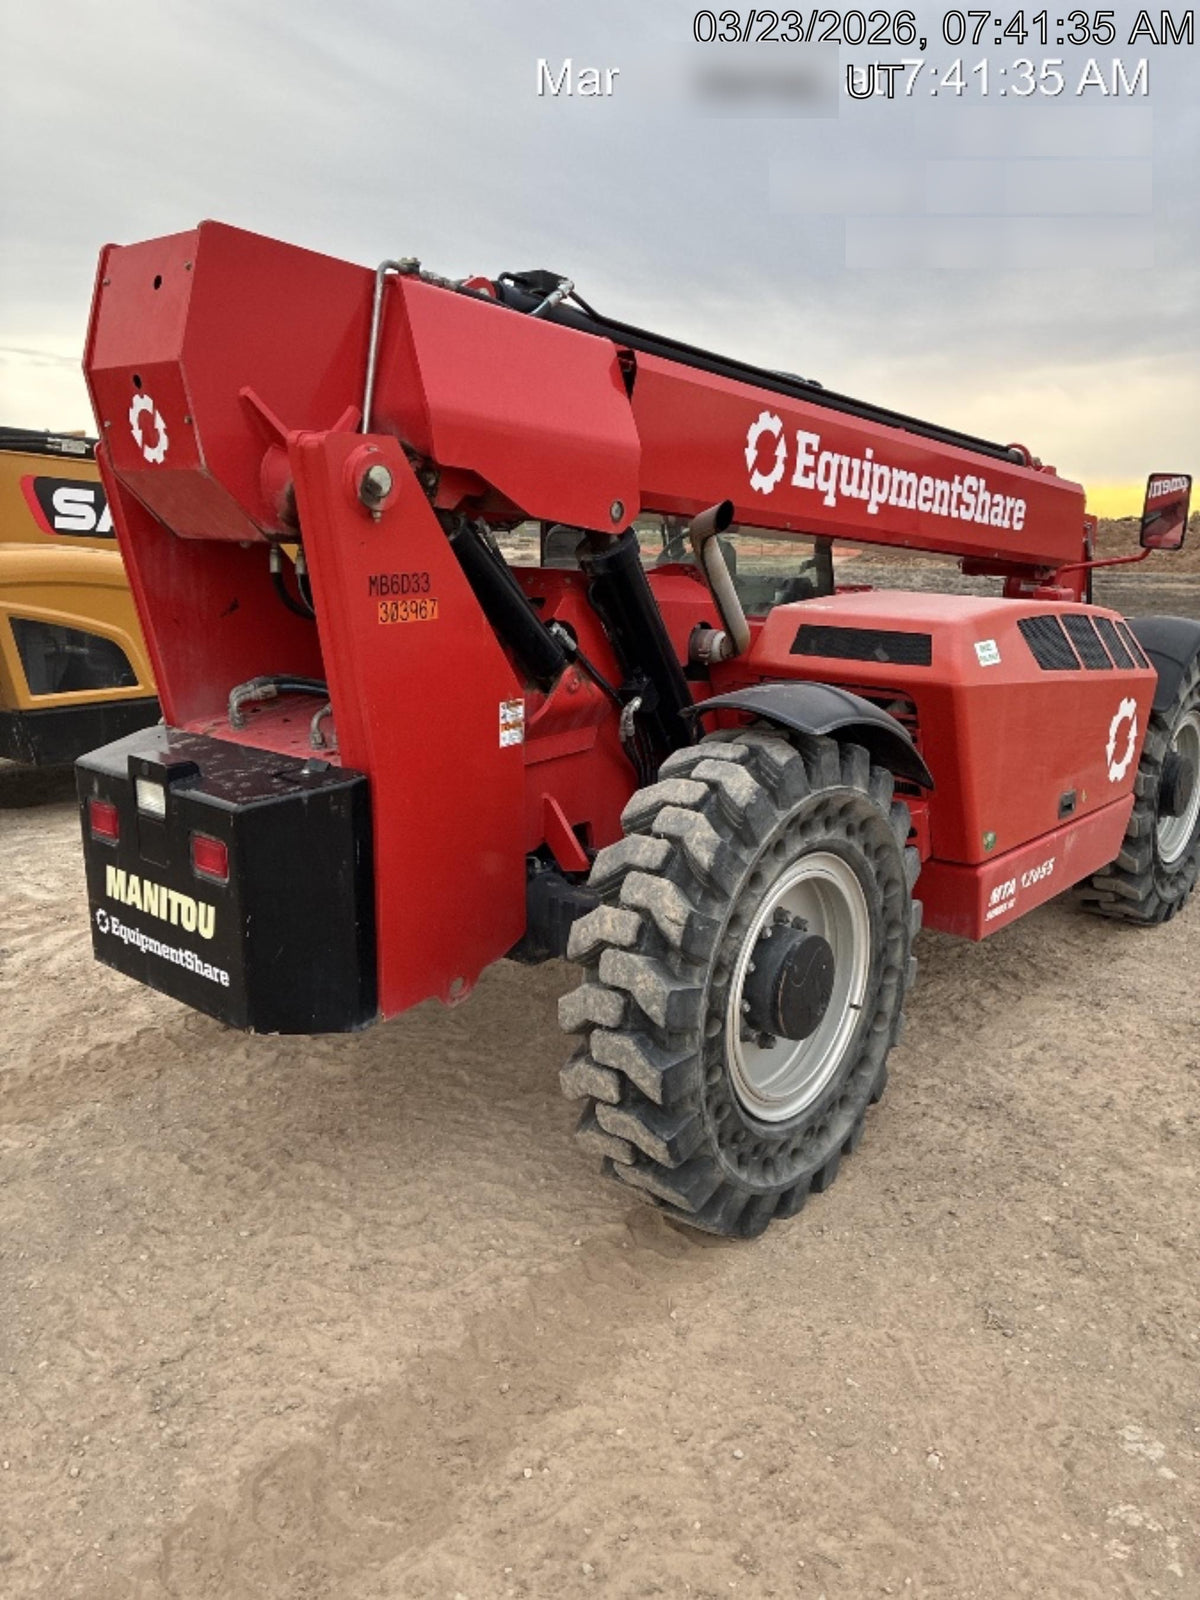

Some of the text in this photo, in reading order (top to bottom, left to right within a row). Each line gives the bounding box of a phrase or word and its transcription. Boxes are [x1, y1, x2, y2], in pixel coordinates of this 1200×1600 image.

[791, 429, 1027, 532] EquipmentShare
[369, 572, 430, 597] MB6D33
[379, 598, 438, 623] 303967
[105, 864, 216, 940] MANITOU
[110, 916, 230, 988] EquipmentShare
